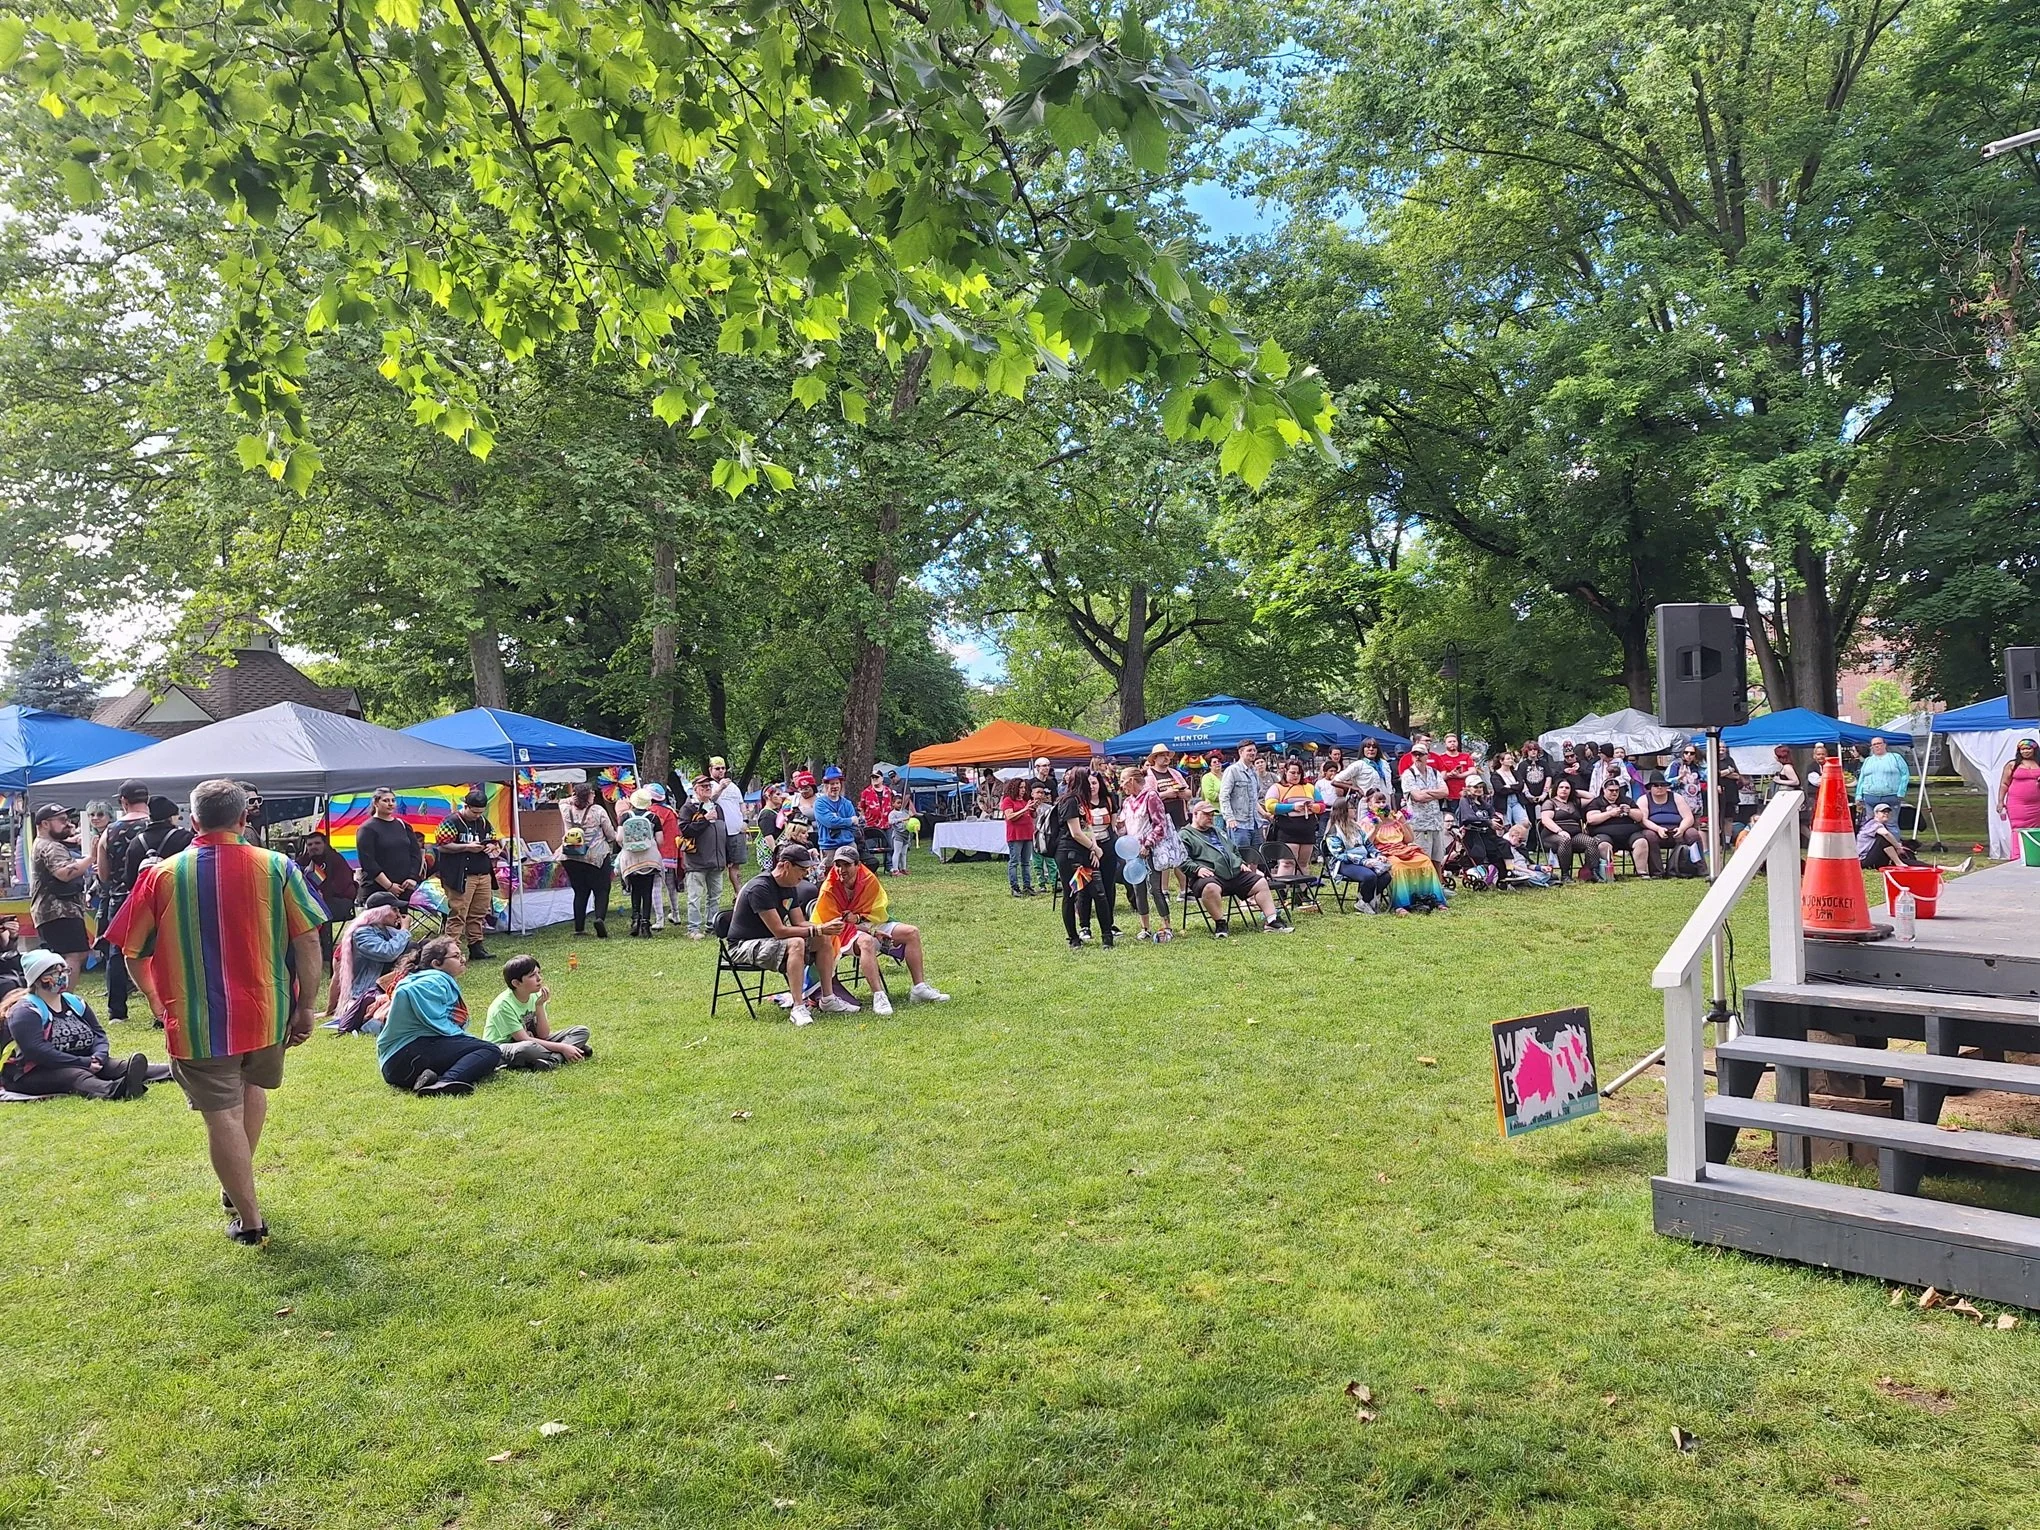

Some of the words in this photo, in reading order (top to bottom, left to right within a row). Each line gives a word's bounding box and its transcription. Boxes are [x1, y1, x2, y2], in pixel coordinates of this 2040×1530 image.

[1174, 734, 1209, 742] MENTOR
[51, 1035, 74, 1045] ARE
[75, 1038, 94, 1047] AC
